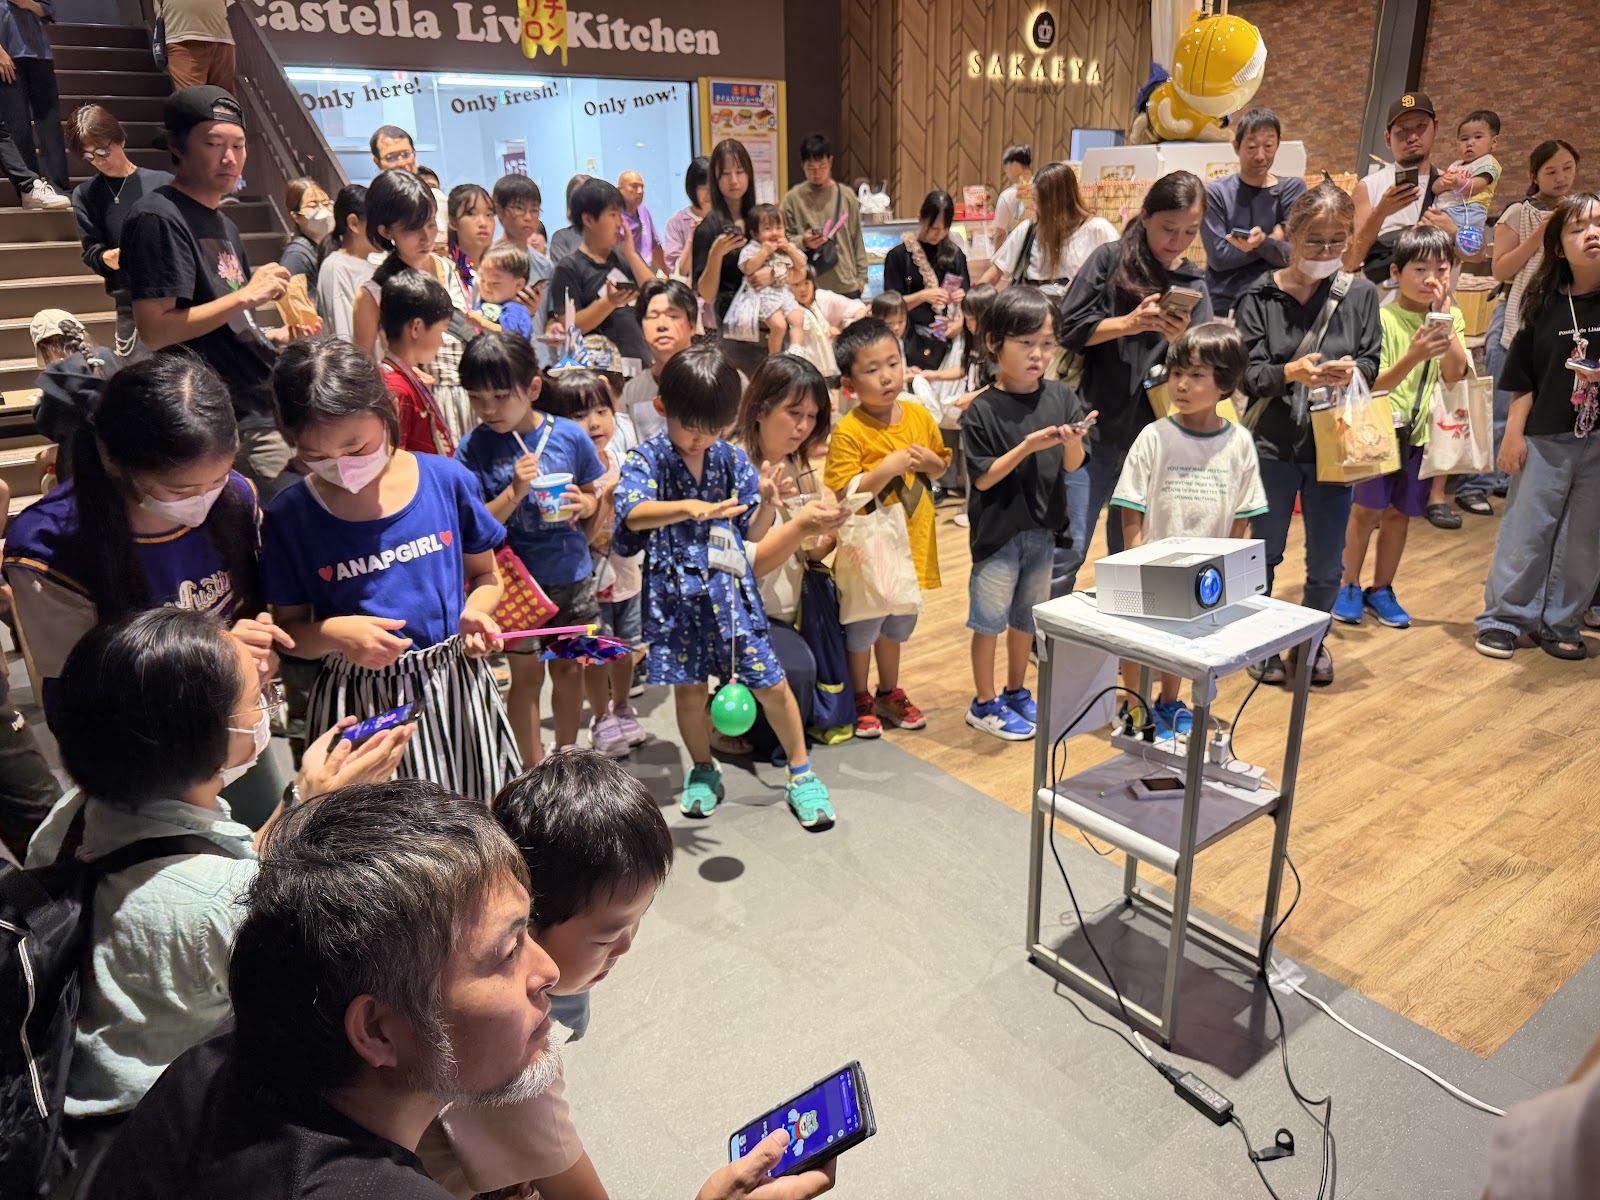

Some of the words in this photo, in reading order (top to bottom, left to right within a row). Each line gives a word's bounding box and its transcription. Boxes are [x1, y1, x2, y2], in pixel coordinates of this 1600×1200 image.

[453, 2, 521, 44] Liv
[566, 11, 721, 56] Kitchen
[970, 53, 1101, 83] SAKAEYA
[300, 88, 355, 111] Only
[362, 77, 422, 102] here!
[451, 94, 498, 114] Only
[502, 82, 560, 106] fresh!
[583, 96, 629, 117] Only
[633, 86, 678, 107] now!
[336, 533, 443, 581] ANAPGIRL
